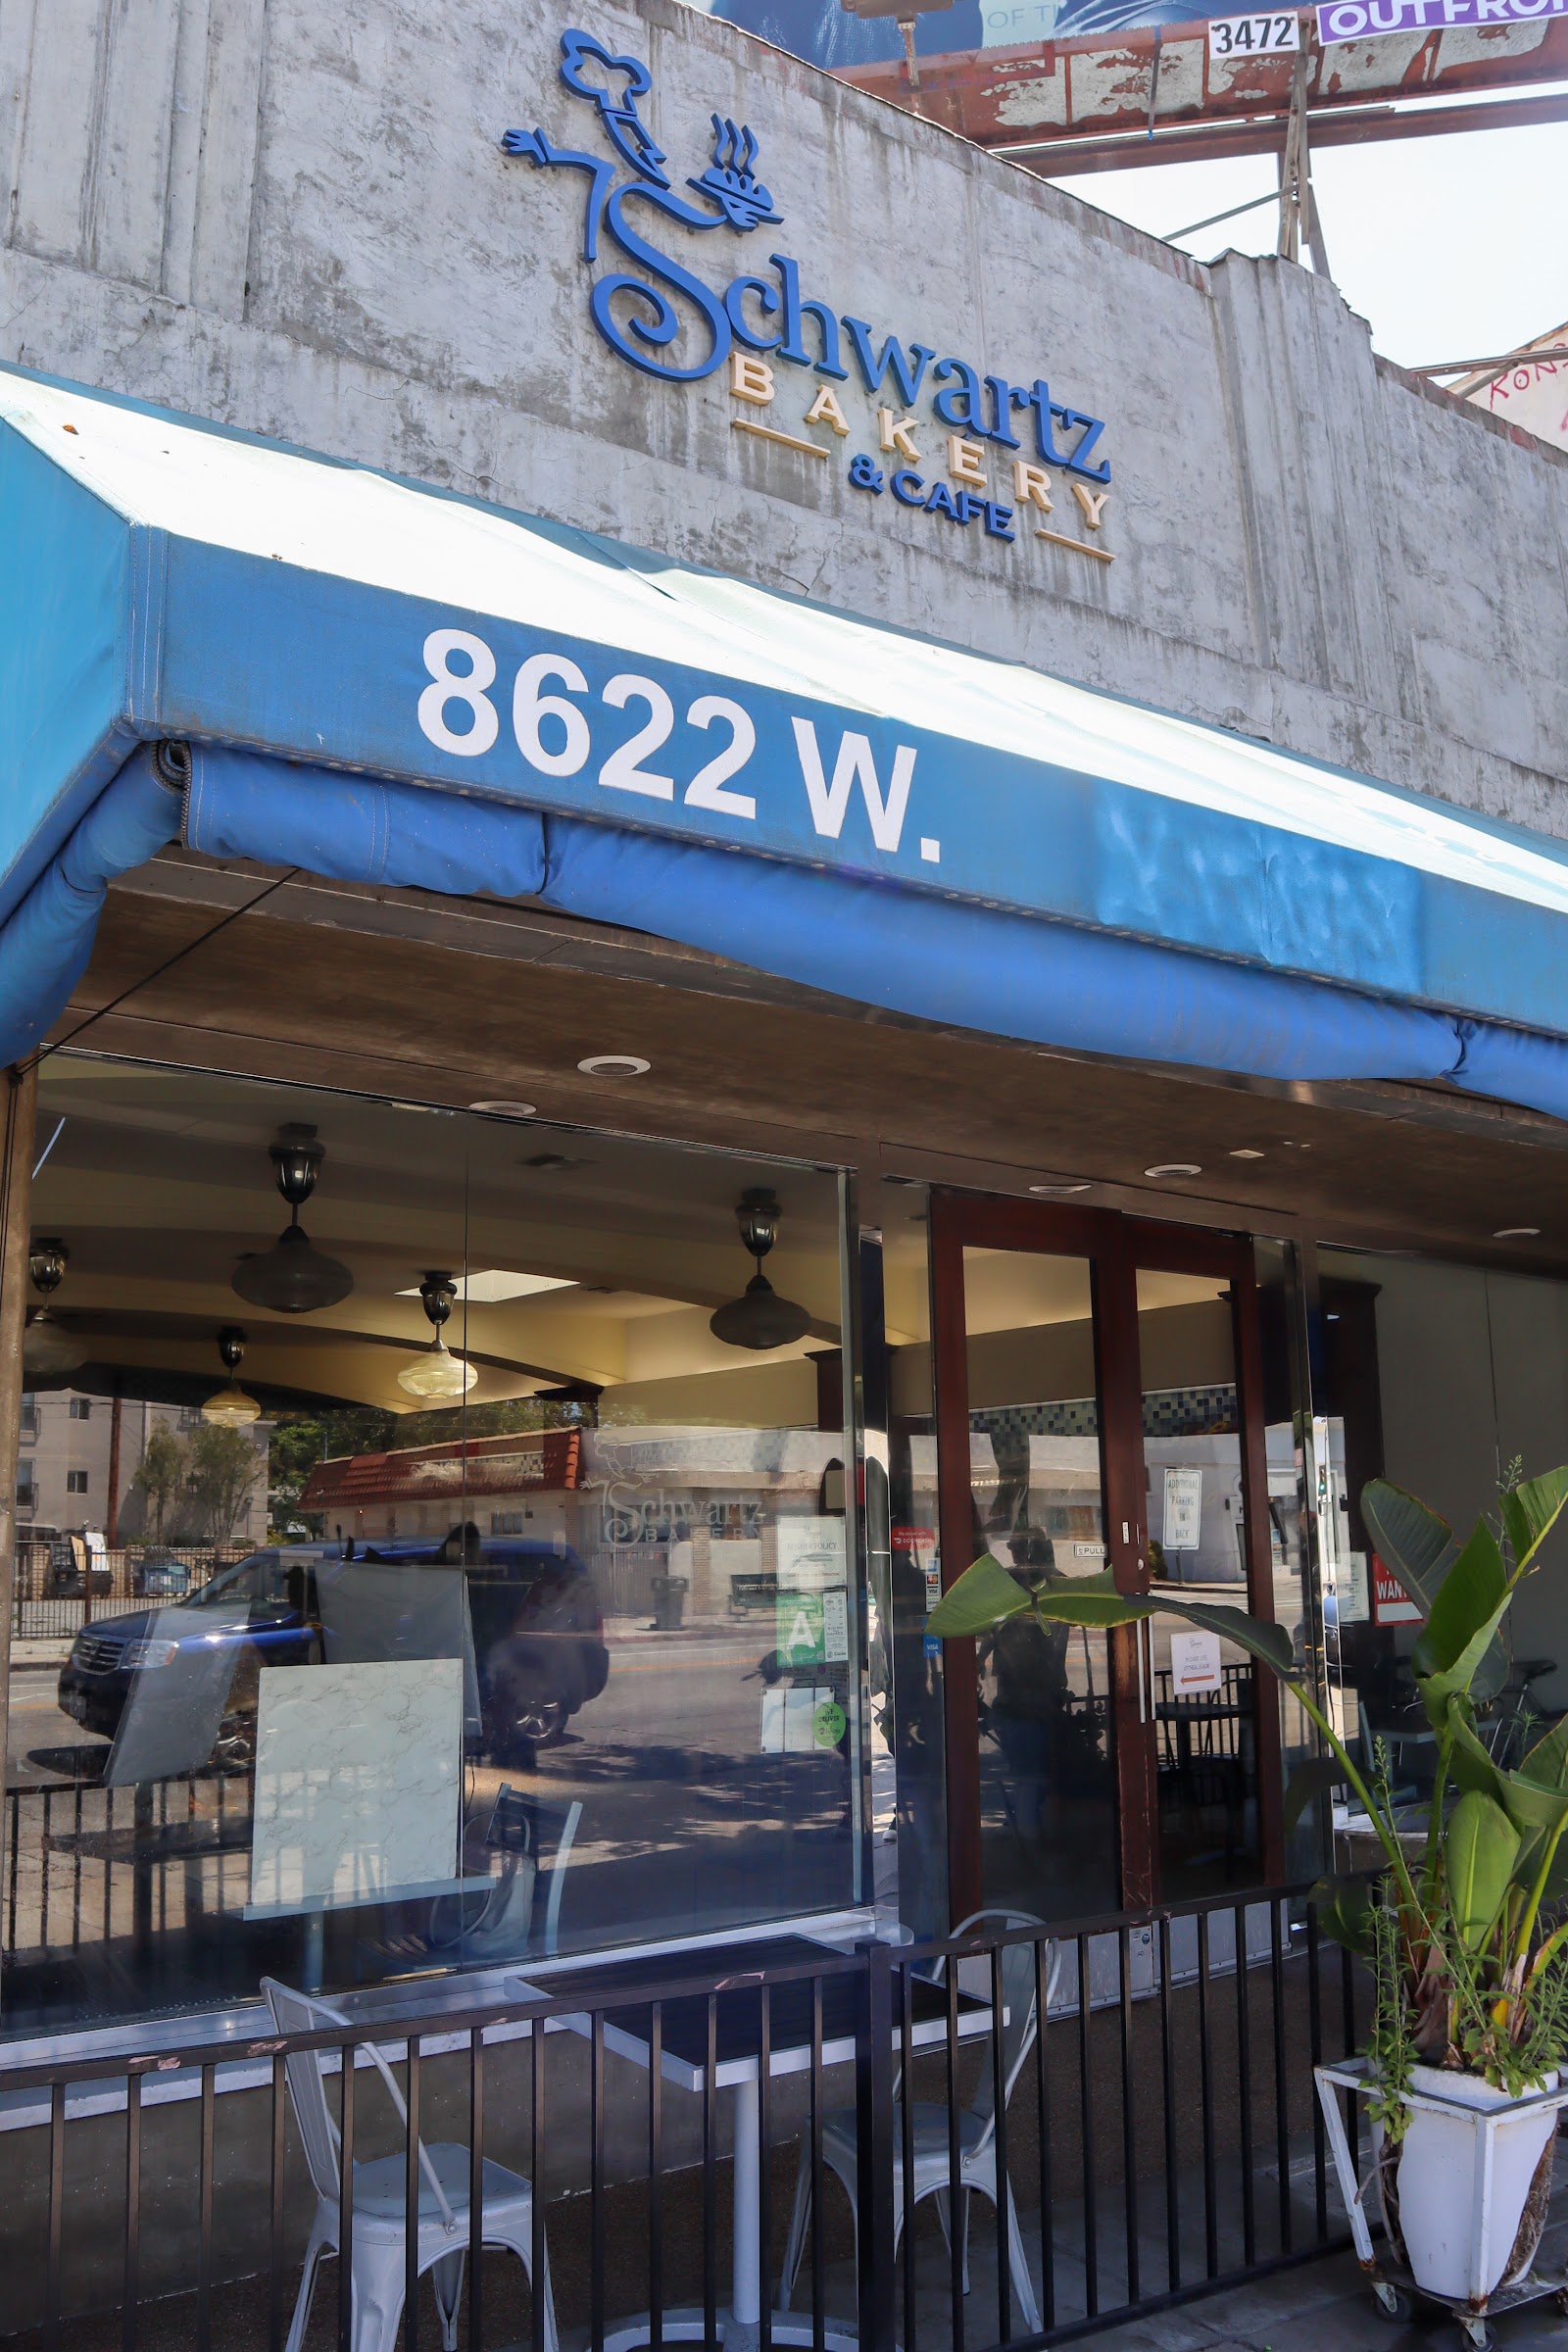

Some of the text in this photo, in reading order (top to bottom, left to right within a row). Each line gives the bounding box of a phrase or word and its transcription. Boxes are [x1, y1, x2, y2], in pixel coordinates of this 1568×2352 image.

[987, 8, 1025, 29] OF
[1215, 17, 1294, 54] 3472
[1329, 0, 1568, 36] OUTFRO
[590, 181, 1111, 485] Schwartz
[729, 351, 1109, 530] BAKERY
[849, 454, 1015, 543] & CAFE
[417, 628, 941, 863] 8622 W.
[1168, 1479, 1200, 1490] ADDITIONAL
[1171, 1495, 1195, 1506] PARKING
[604, 1482, 764, 1548] Schwartz
[1179, 1512, 1186, 1522] IN
[787, 1541, 838, 1550] KOSHER POLICY
[1175, 1529, 1190, 1540] BACK
[1376, 1579, 1407, 1600] WAN
[786, 1611, 816, 1651] A
